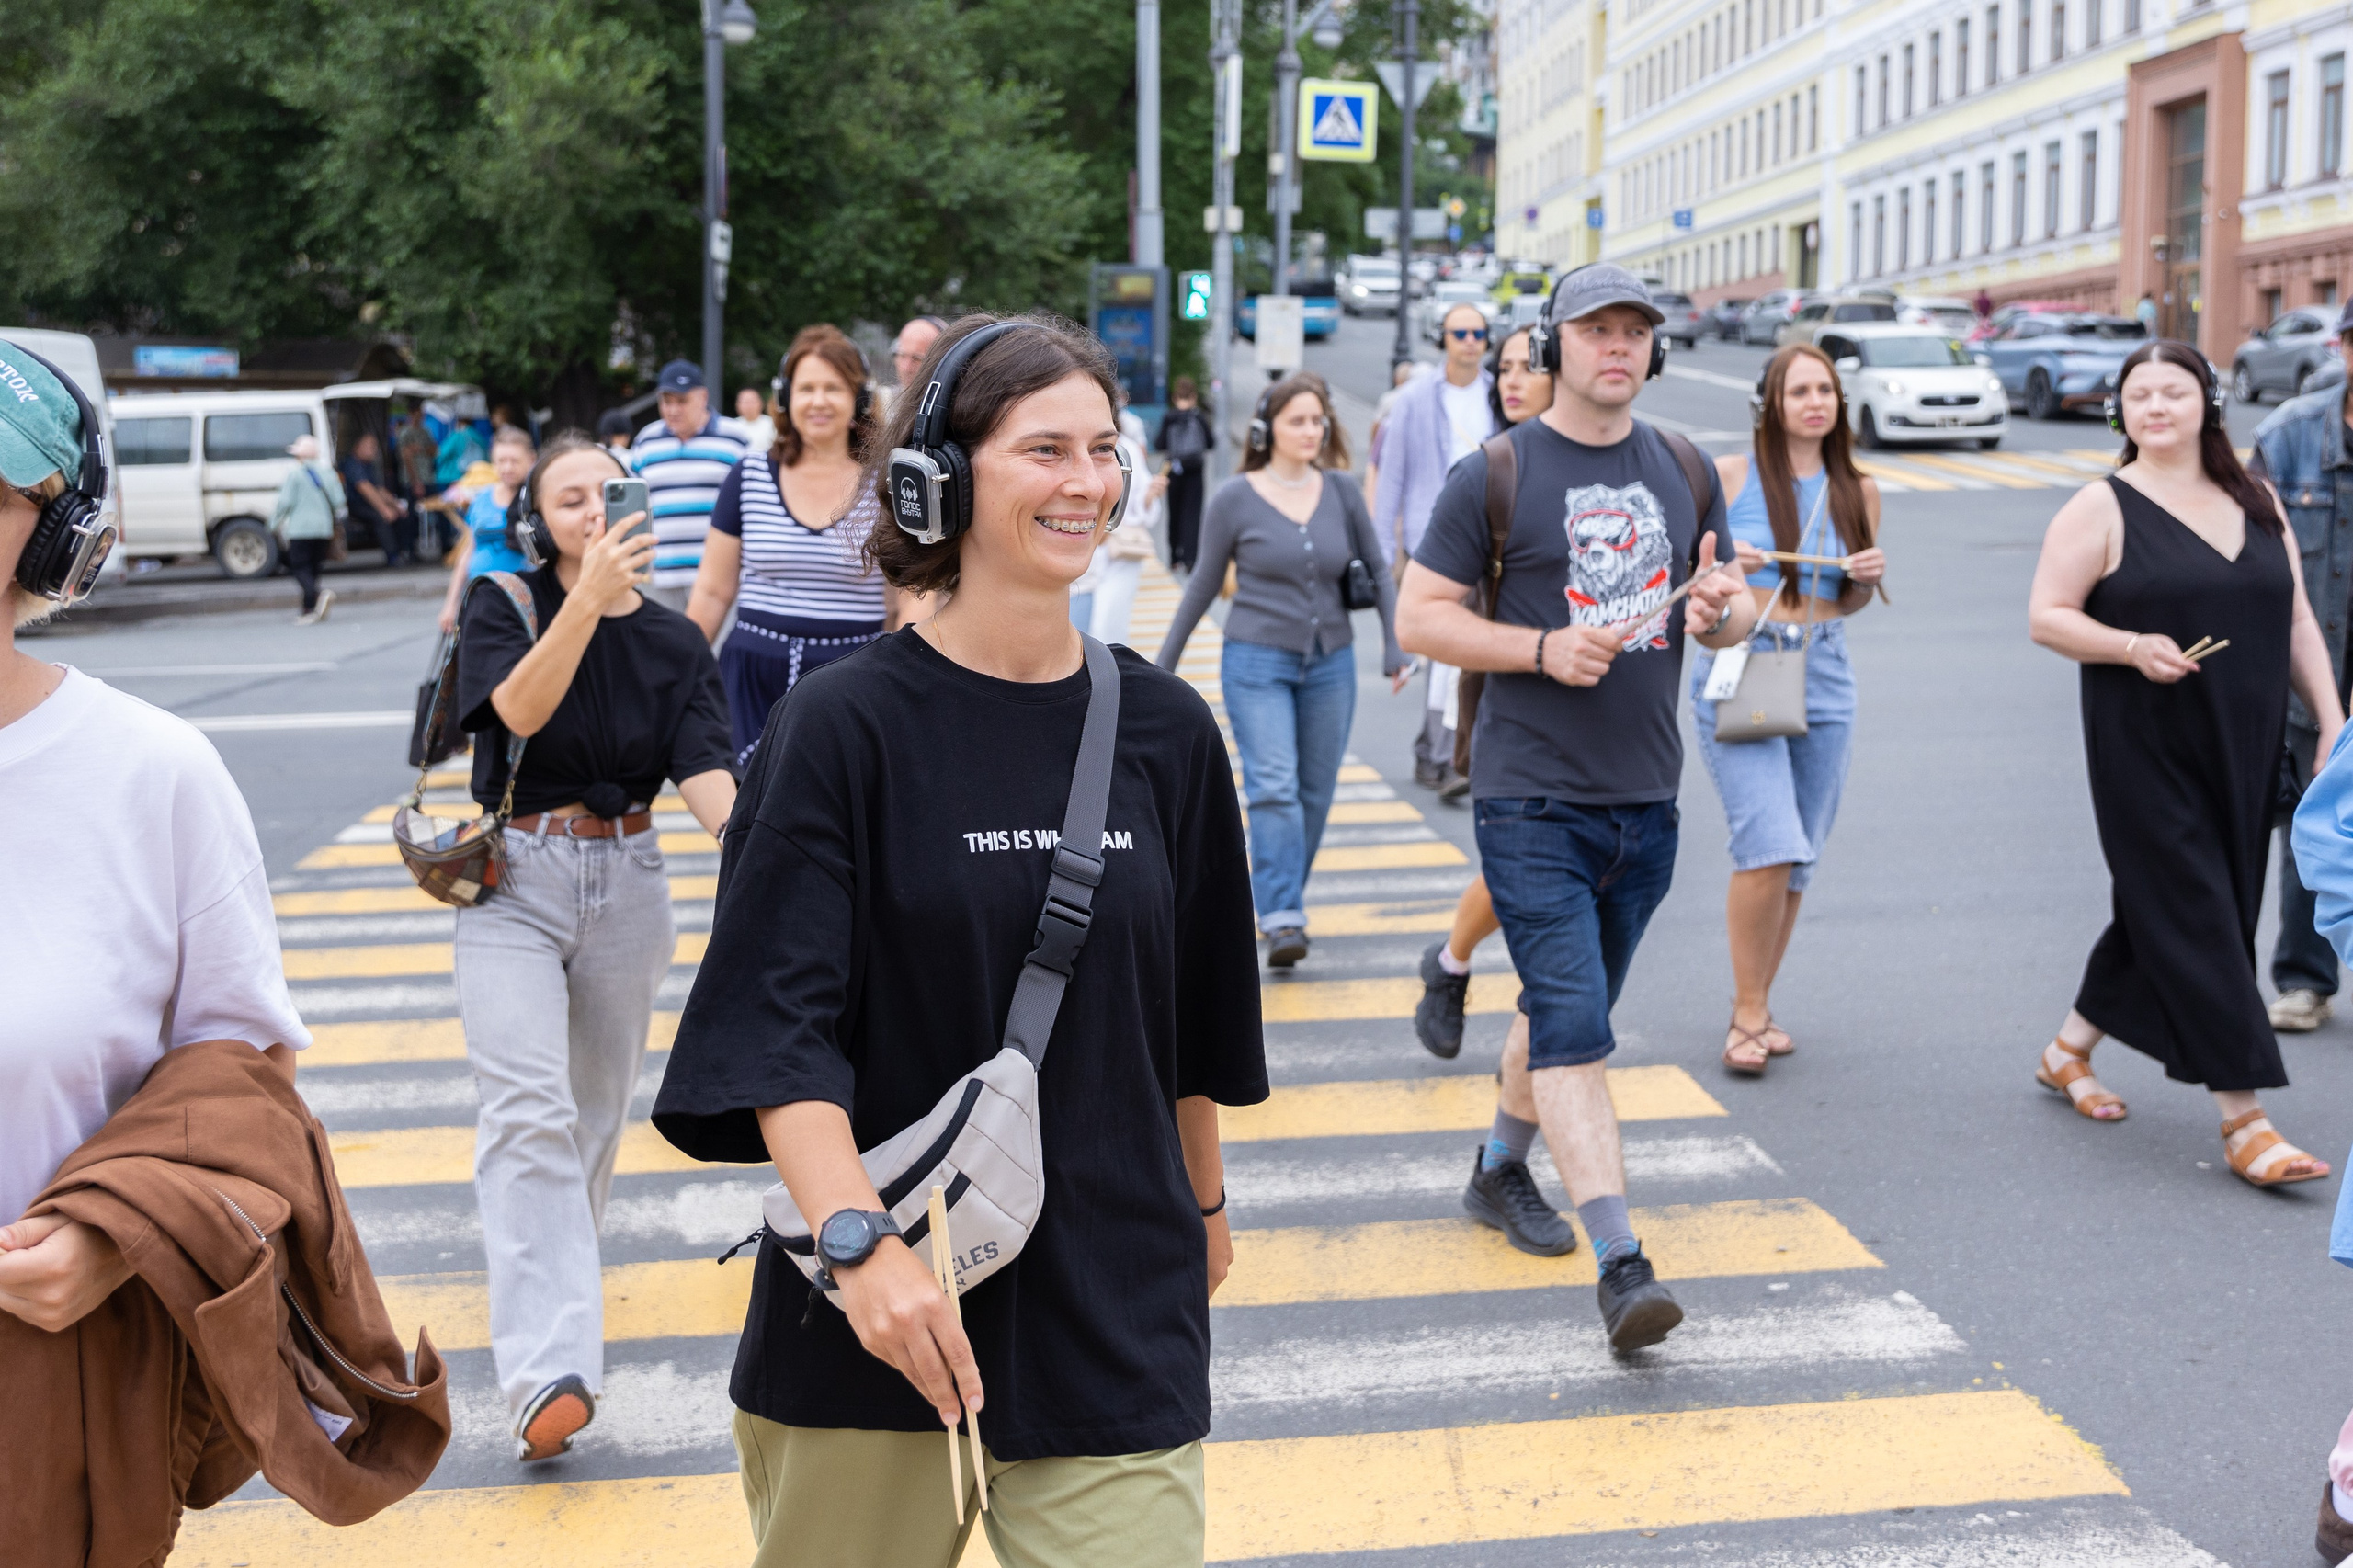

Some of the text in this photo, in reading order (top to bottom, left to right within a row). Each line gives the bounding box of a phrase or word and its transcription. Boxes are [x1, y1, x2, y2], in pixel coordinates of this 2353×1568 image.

[901, 500, 920, 511] ГОЛОС
[901, 507, 921, 518] ВНУТРИ
[963, 830, 1011, 853] THIS
[1013, 830, 1033, 850] IS
[1101, 831, 1133, 850] AM
